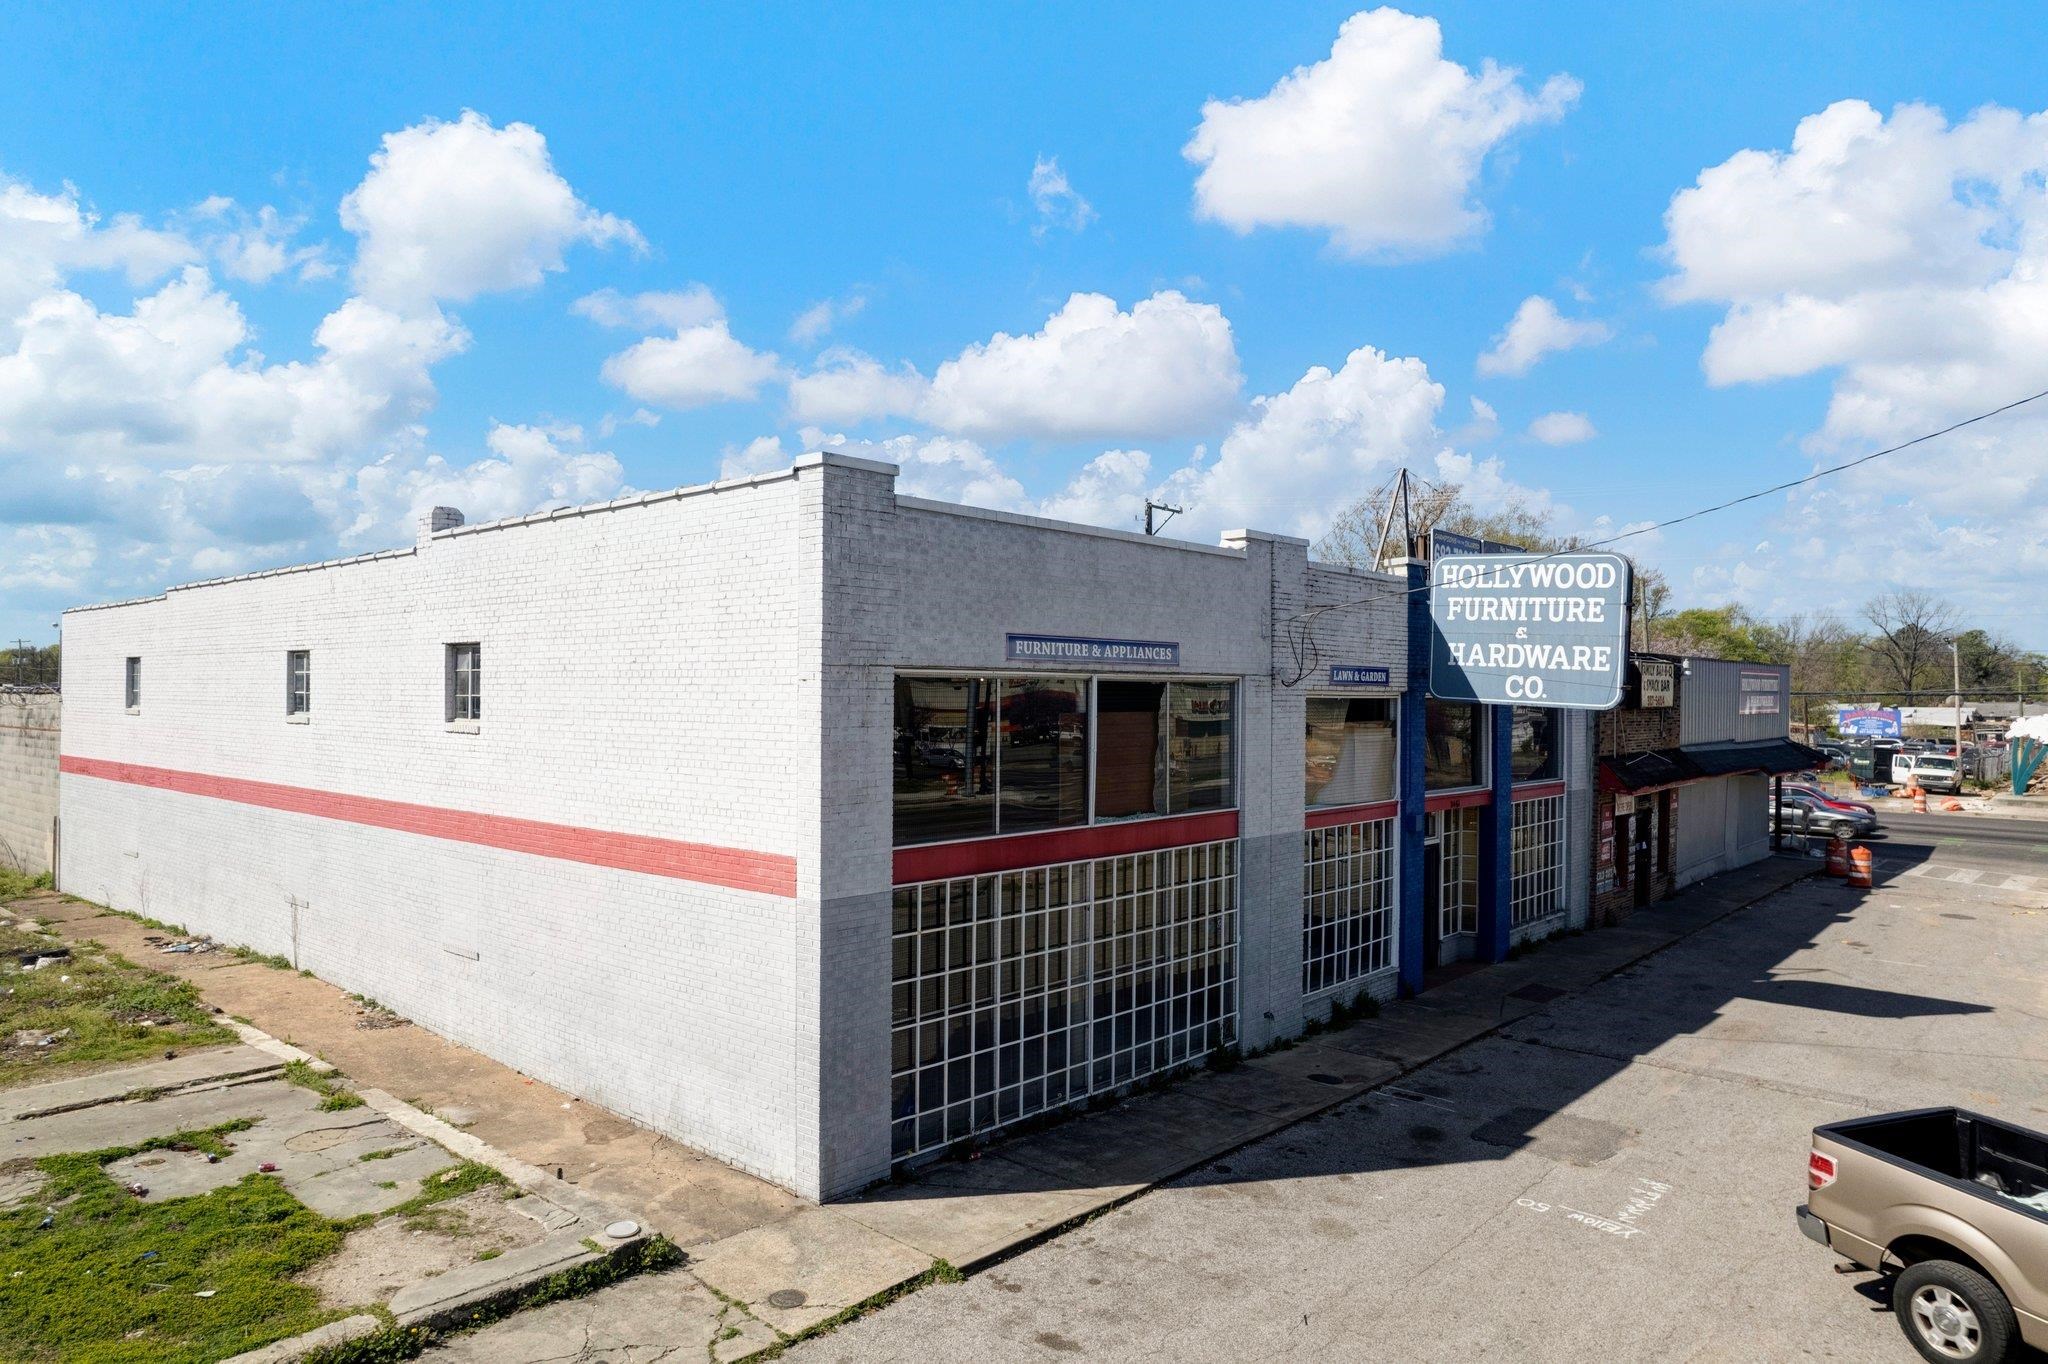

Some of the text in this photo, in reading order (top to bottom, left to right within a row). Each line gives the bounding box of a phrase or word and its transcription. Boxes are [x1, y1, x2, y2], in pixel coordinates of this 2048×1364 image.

[1441, 563, 1616, 589] HOLLYWOOD
[1447, 597, 1605, 622] FURNITURE
[1515, 627, 1528, 639] &
[1016, 640, 1172, 660] FURNITURE & APPLIANCES
[1448, 642, 1611, 671] HARDWARE
[1333, 670, 1387, 682] LAWN & GARDEN
[1505, 675, 1547, 698] CO.
[1660, 679, 1671, 692] BAR
